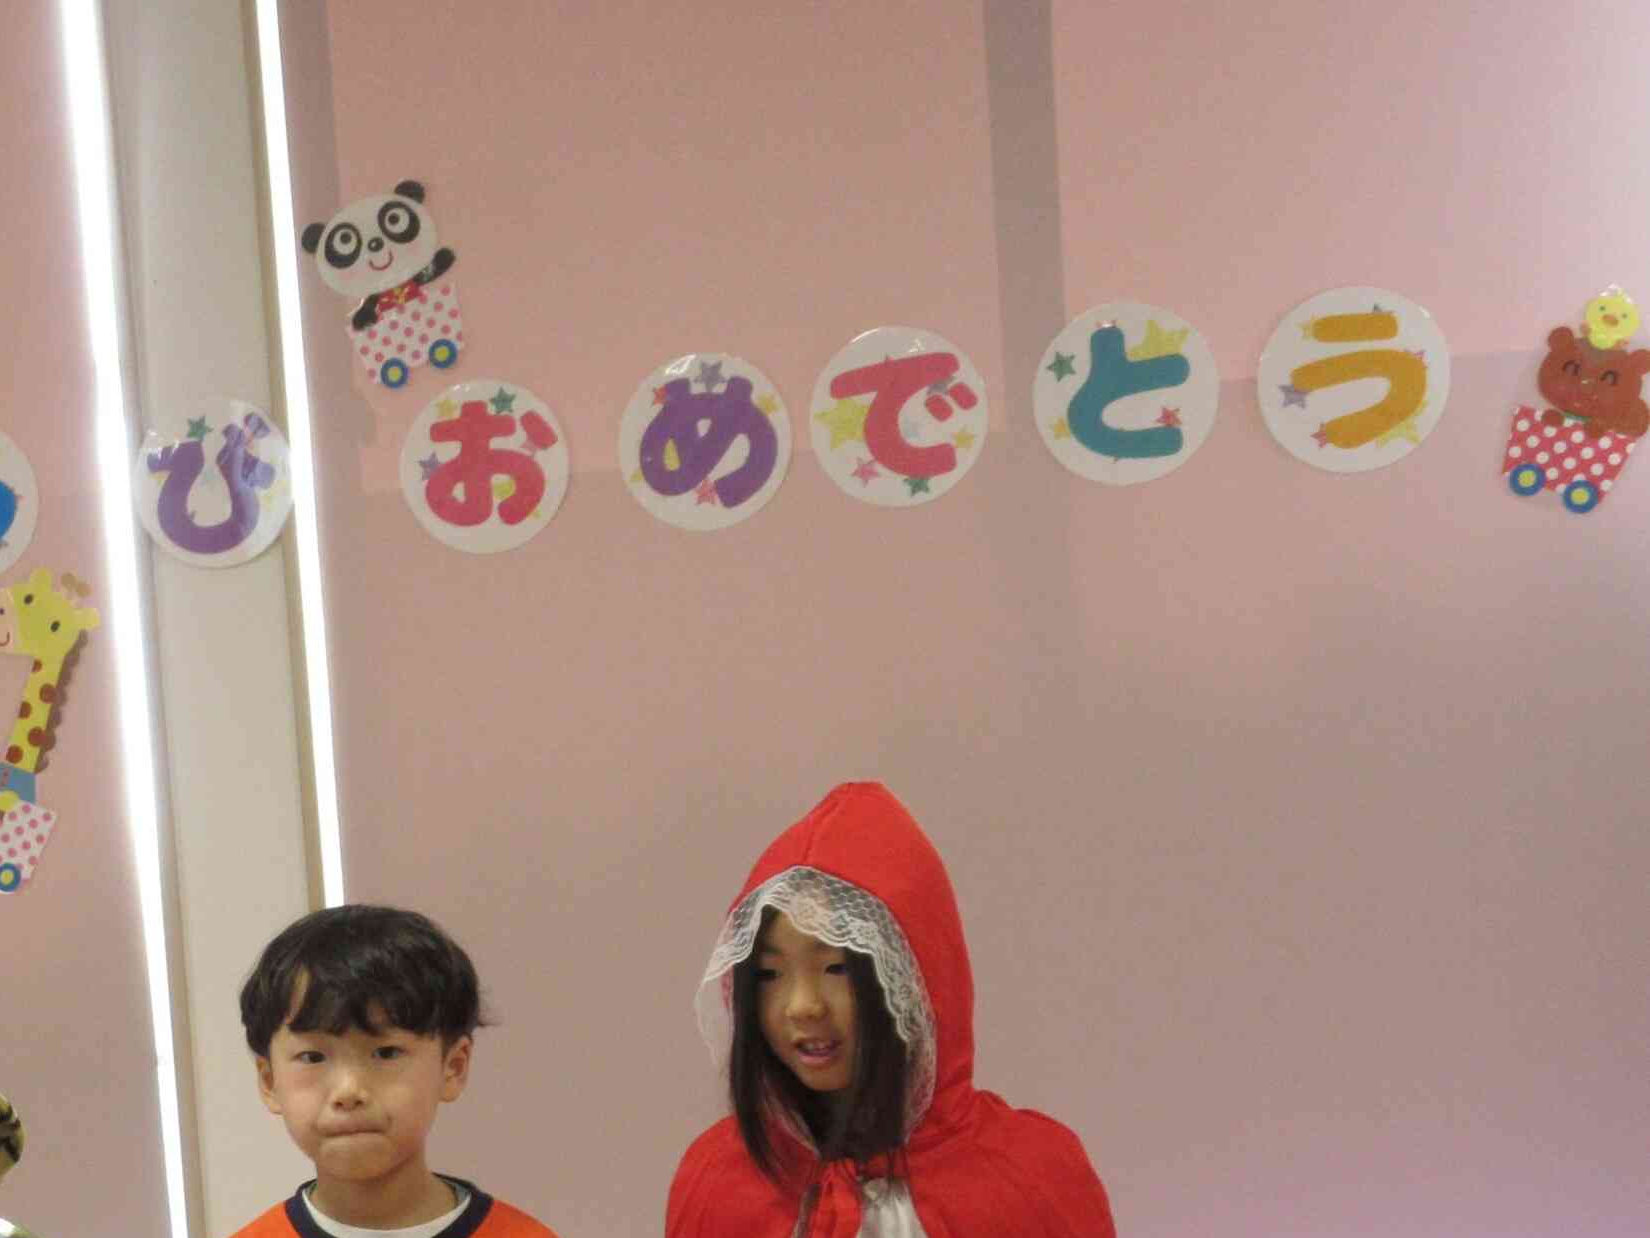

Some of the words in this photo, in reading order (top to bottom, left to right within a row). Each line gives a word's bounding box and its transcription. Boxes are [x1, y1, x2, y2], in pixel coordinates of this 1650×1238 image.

[424, 312, 1427, 527] おめでとう
